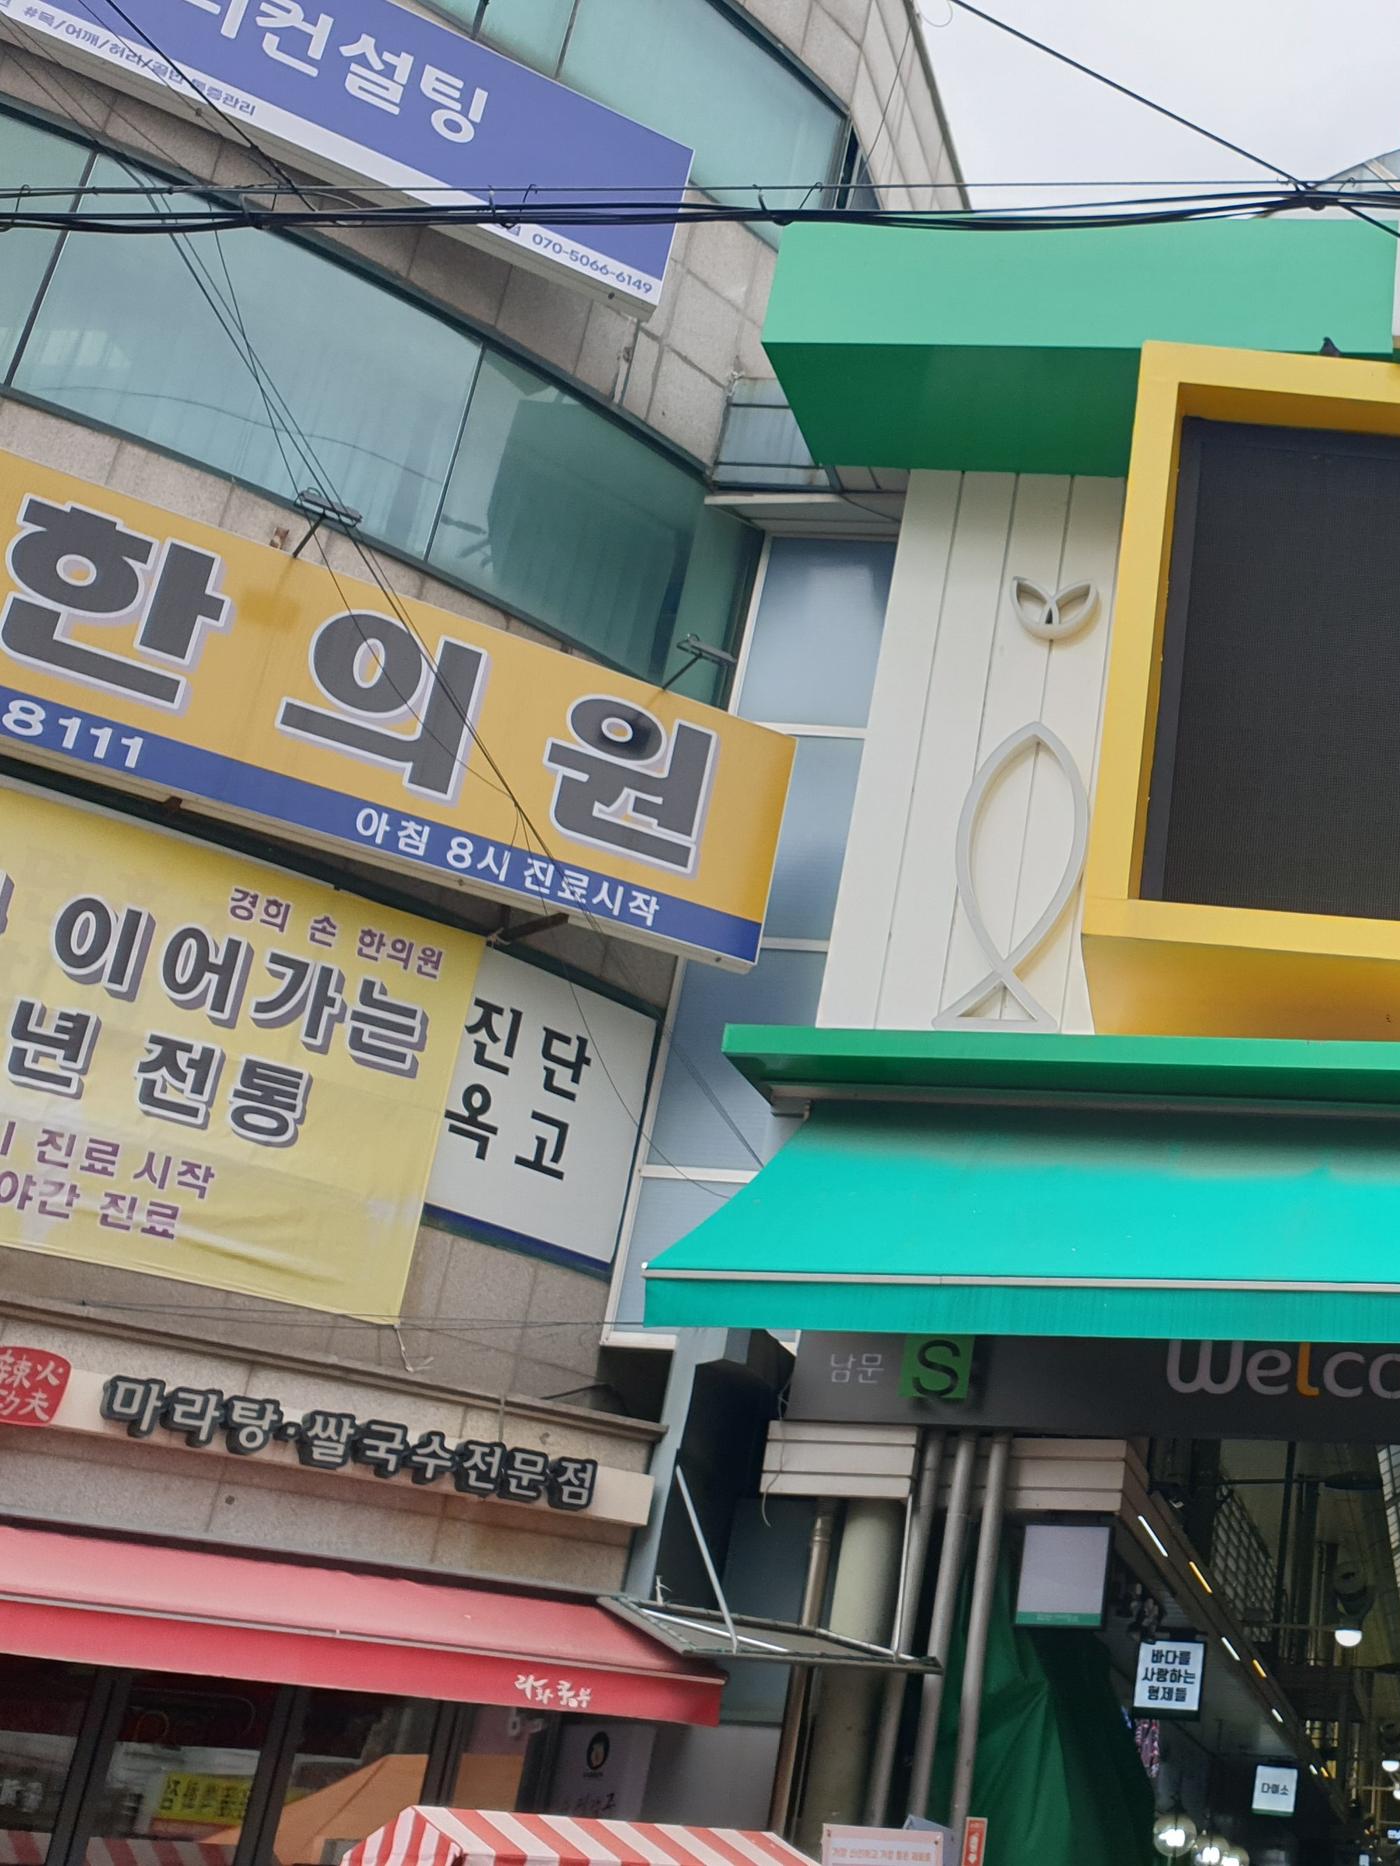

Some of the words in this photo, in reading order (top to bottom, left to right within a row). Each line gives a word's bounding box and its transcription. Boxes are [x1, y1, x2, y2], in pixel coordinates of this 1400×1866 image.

[531, 231, 653, 295] 070-5066-6149
[1, 699, 144, 769] 8111
[355, 807, 431, 857] 아침
[446, 836, 510, 883] 8시
[523, 856, 660, 927] 진료시작
[229, 887, 292, 933] 경희
[309, 915, 338, 948] 손
[357, 927, 444, 980] 한의원
[52, 896, 429, 1079] 이어가는
[6, 998, 101, 1100] 년
[135, 1031, 312, 1148] 전통
[464, 996, 591, 1101] 진단
[36, 1127, 121, 1179] 진료
[132, 1150, 216, 1200] 시작
[444, 1083, 567, 1181] 옥고
[98, 1190, 180, 1241] 진료
[830, 1353, 885, 1385] 남문
[911, 1339, 961, 1397] S
[1142, 1667, 1196, 1685] 사랑하는
[1151, 1649, 1191, 1666] 바다를
[1147, 1685, 1188, 1703] 형제들
